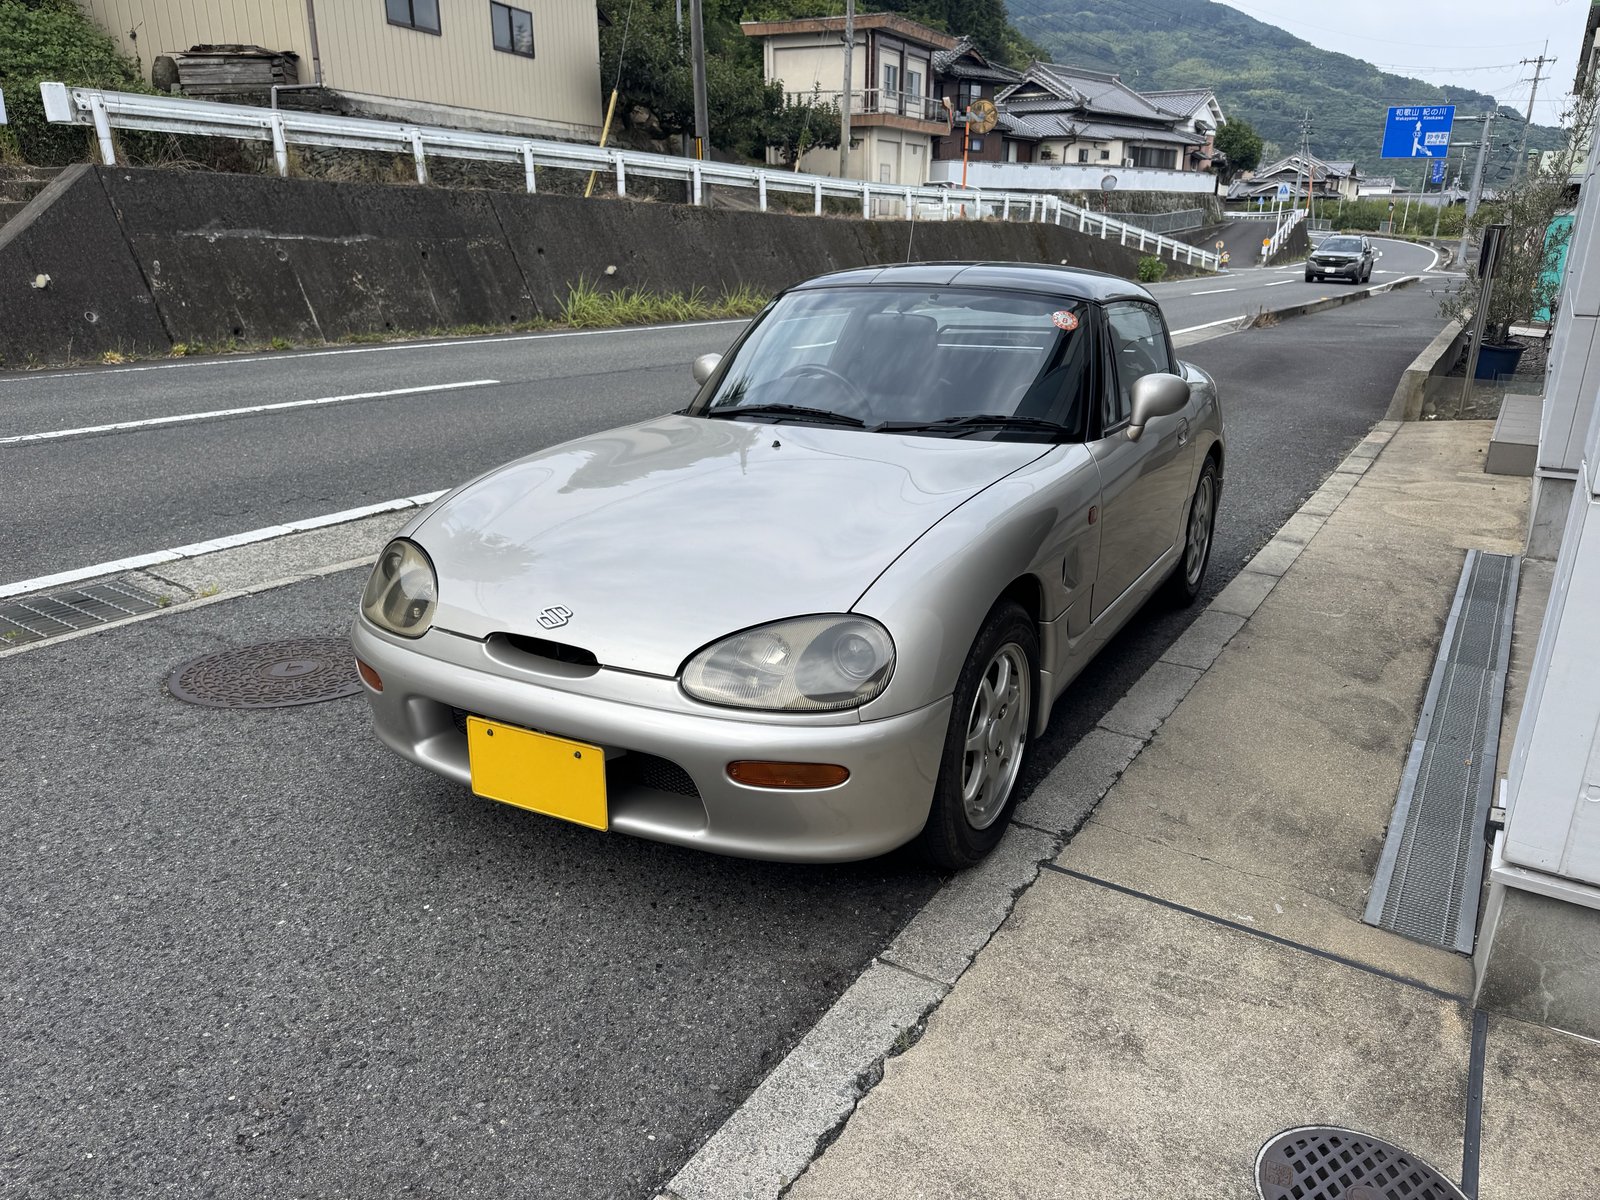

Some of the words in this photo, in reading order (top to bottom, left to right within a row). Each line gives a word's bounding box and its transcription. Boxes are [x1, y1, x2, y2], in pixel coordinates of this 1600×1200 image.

[1396, 108, 1420, 116] 和歌山
[1423, 107, 1447, 116] 紀の川
